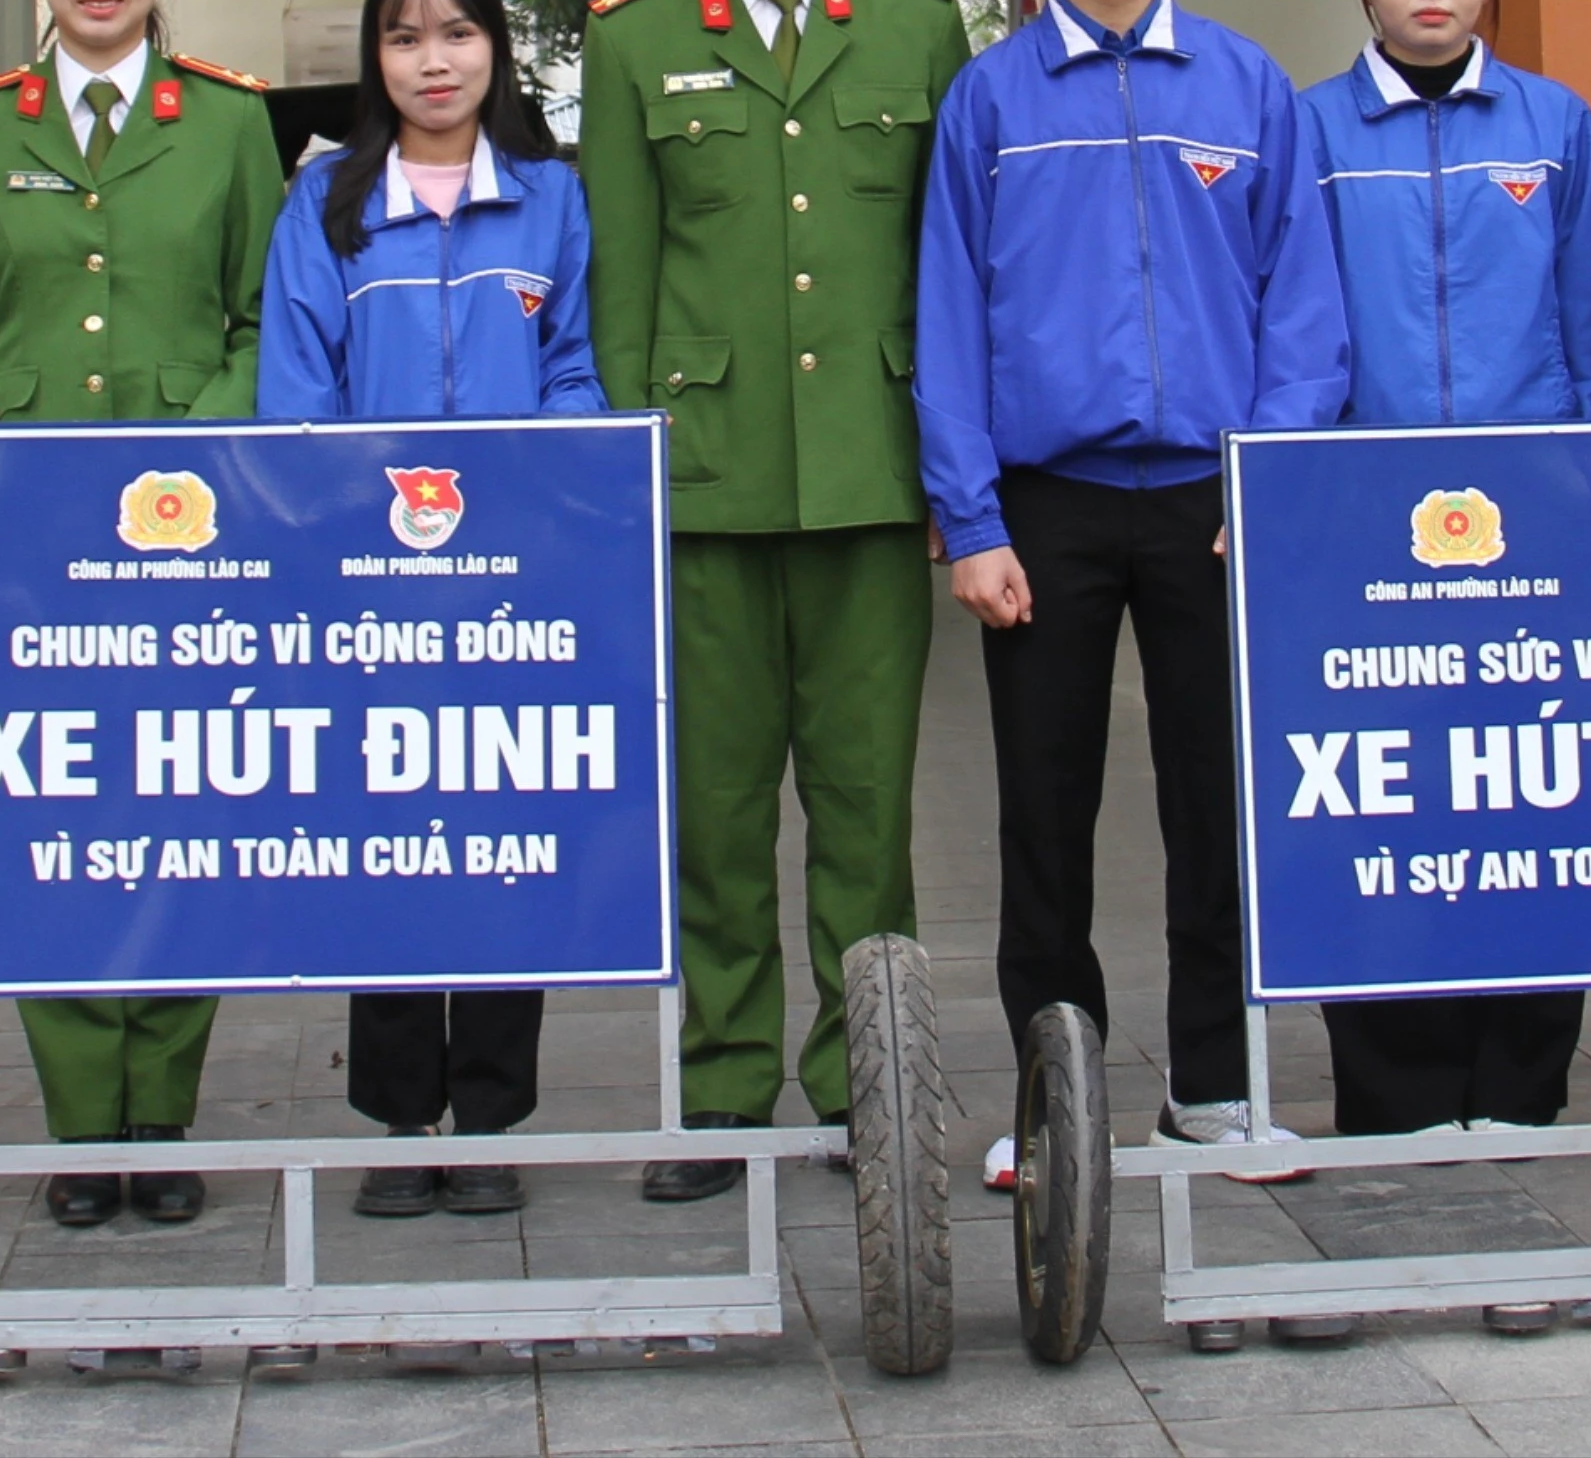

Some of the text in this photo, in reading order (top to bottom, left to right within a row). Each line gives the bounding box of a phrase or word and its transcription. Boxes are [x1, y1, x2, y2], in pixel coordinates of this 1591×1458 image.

[69, 557, 269, 579] CÔNG AN PHƯỜNG LÀO CAI
[342, 551, 517, 575] ĐOÀN PHƯỜNG LÀO CAI
[1366, 577, 1559, 601] CÔNG AN PHƯỜNG LÀO CAI
[12, 602, 575, 673] CHUNG SỨC VÌ CỘNG ĐỒNG
[1324, 644, 1465, 689] CHUNG
[1479, 629, 1561, 683] SỨC
[136, 687, 330, 795] HÚT
[362, 705, 615, 792] ĐINH
[1287, 730, 1414, 817] XE
[31, 831, 71, 880] VÌ
[87, 837, 150, 890] SỰ
[158, 840, 219, 878] AN
[233, 827, 348, 877] TOÀN
[466, 835, 556, 884] BẠN
[1355, 847, 1394, 895] VÌ
[1410, 850, 1470, 901] SỰ
[1479, 851, 1537, 890] AN
